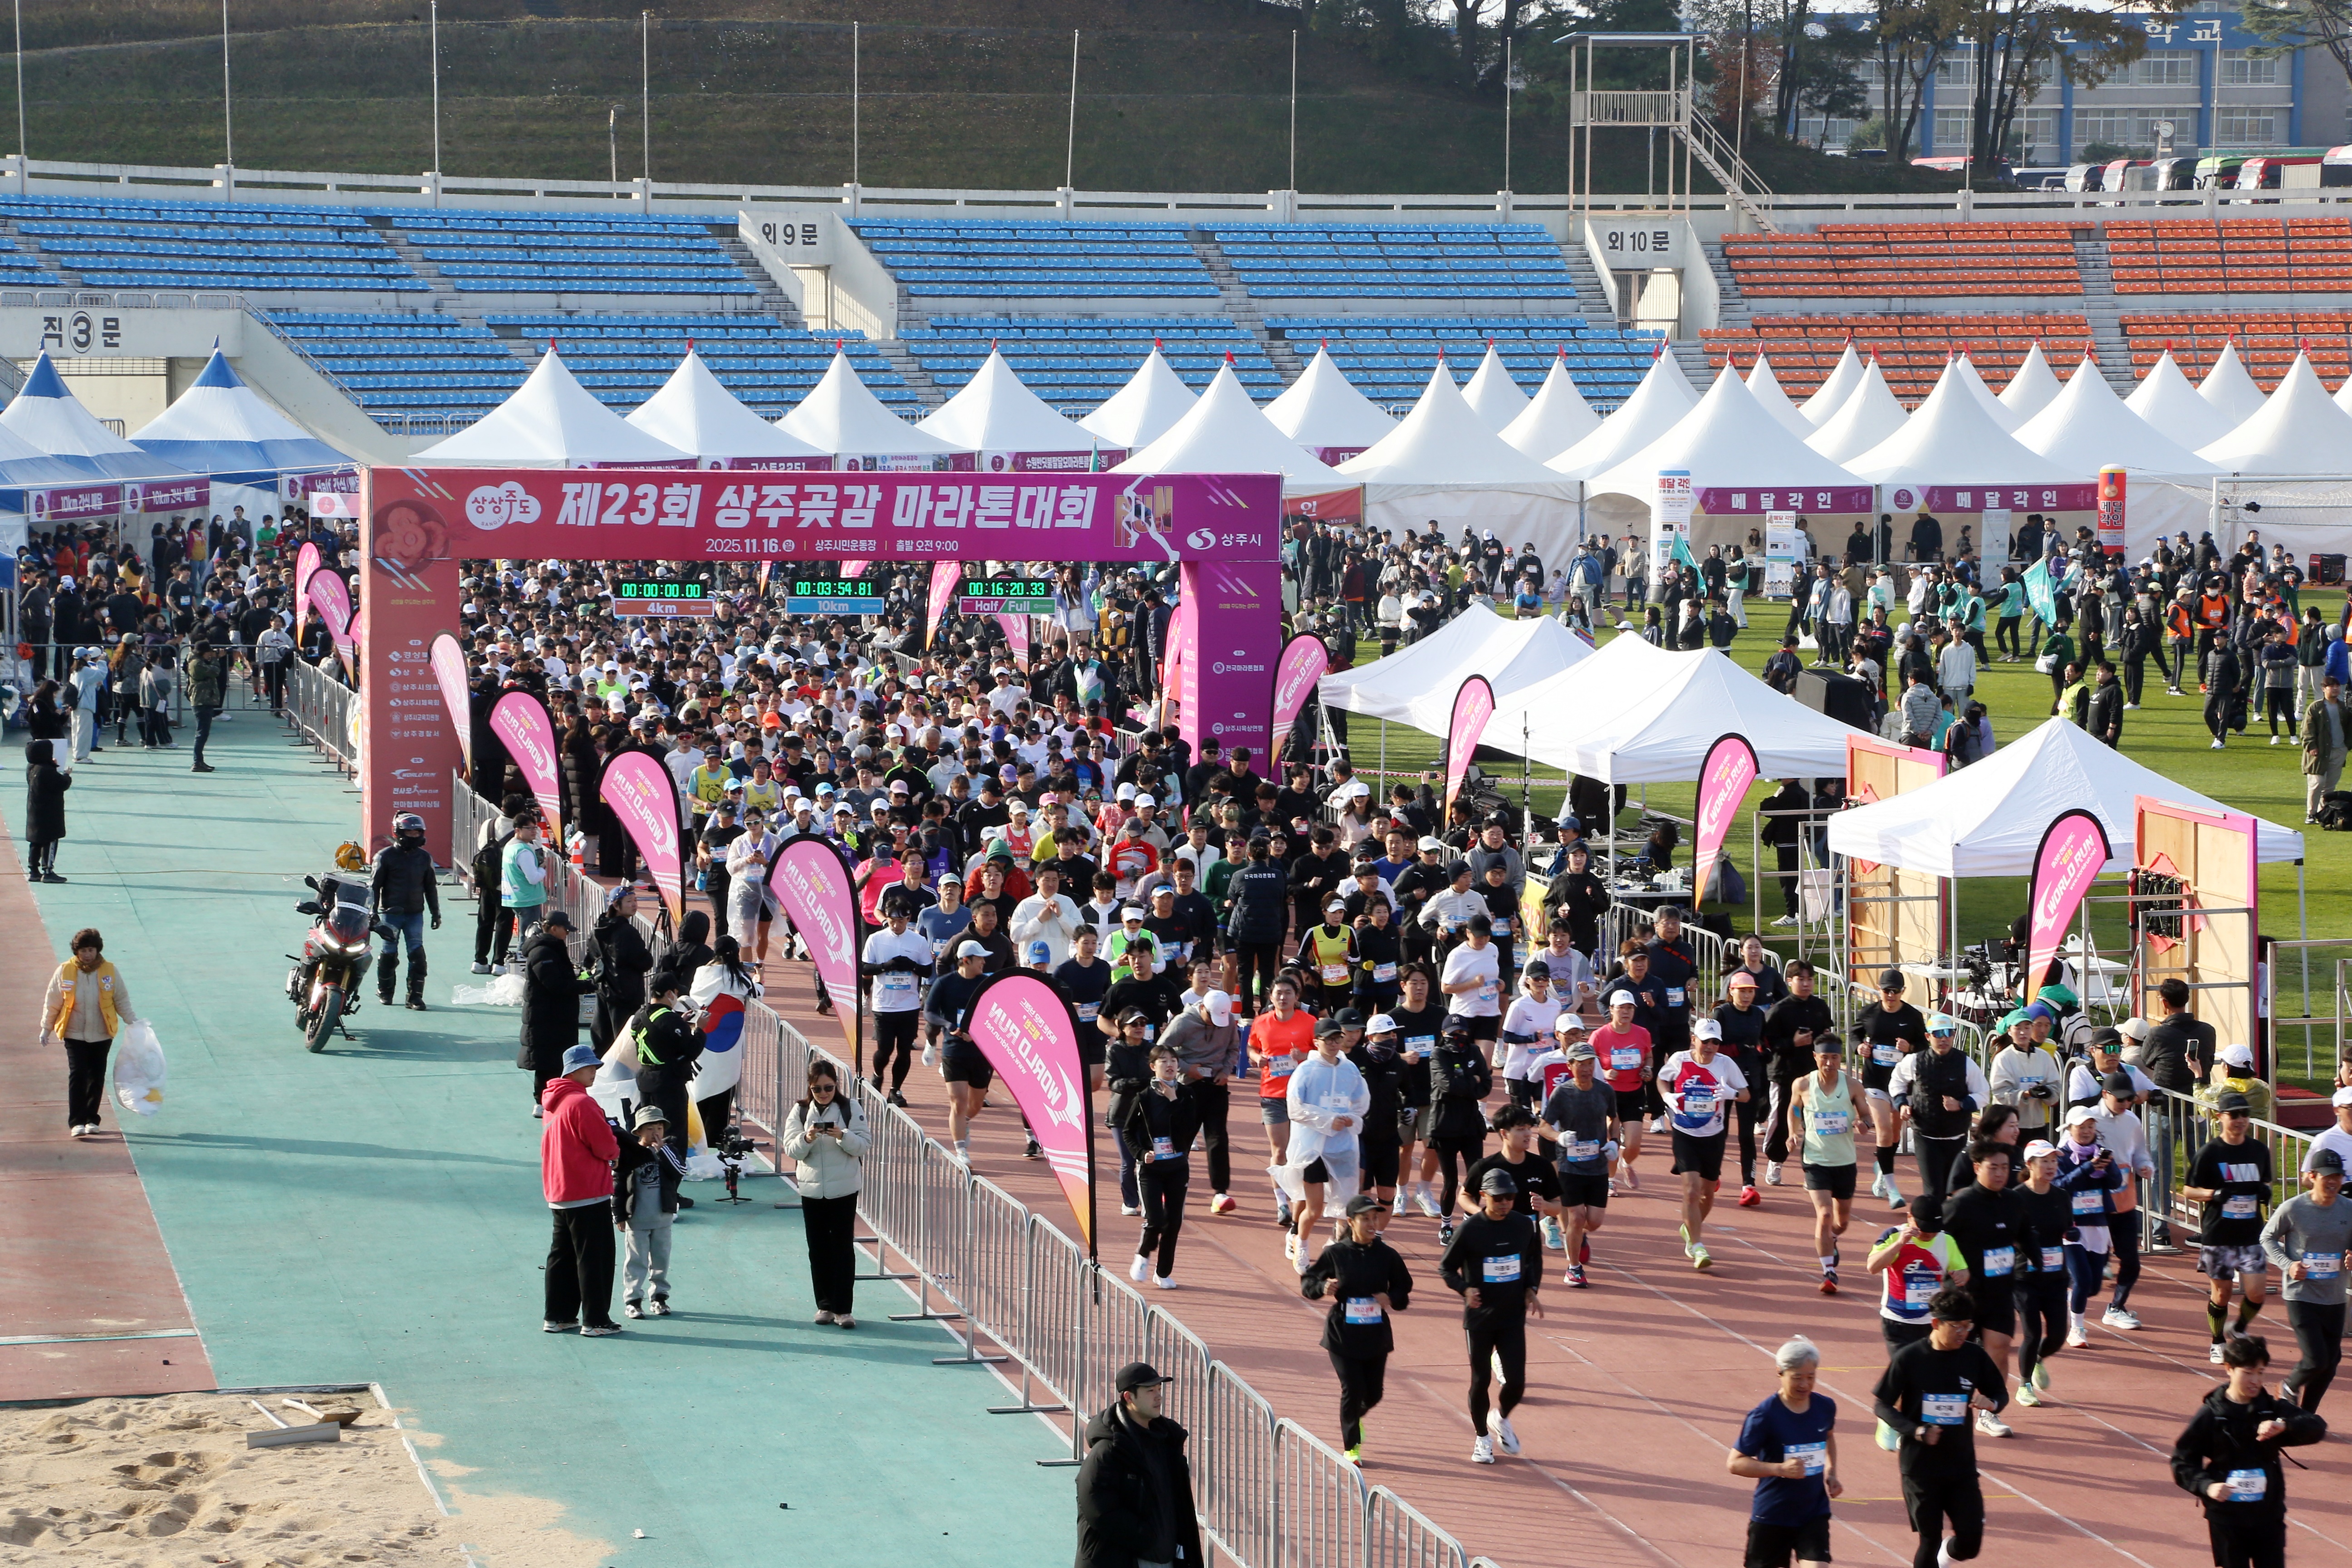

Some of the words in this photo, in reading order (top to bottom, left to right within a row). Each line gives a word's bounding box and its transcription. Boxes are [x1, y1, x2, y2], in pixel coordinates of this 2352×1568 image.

[1608, 231, 1670, 252] 외10문
[557, 483, 702, 527] 제23회
[715, 485, 882, 528] 상주곶감
[892, 485, 1097, 529] 마라톤대회
[2100, 500, 2123, 513] 메달
[480, 515, 504, 527] SANGJU
[2100, 513, 2122, 526] 각인
[815, 539, 877, 551] 상주시민운동장
[896, 539, 914, 551] 출발
[916, 539, 933, 551] 오전
[936, 540, 958, 551] 9:00
[1221, 533, 1262, 547] 상주시
[622, 583, 701, 598] 00:00:00.00
[796, 581, 872, 596] 00:03:54.81
[969, 582, 1044, 596] 00:16:20.33
[647, 603, 677, 613] 4km
[818, 600, 849, 611] 10km
[975, 600, 999, 611] Half
[1008, 601, 1030, 612] Full
[1225, 664, 1264, 672] 전국마라톤협회
[1710, 778, 1733, 822] WORLD
[2047, 864, 2076, 915] WORLD
[2073, 833, 2095, 868] RUN
